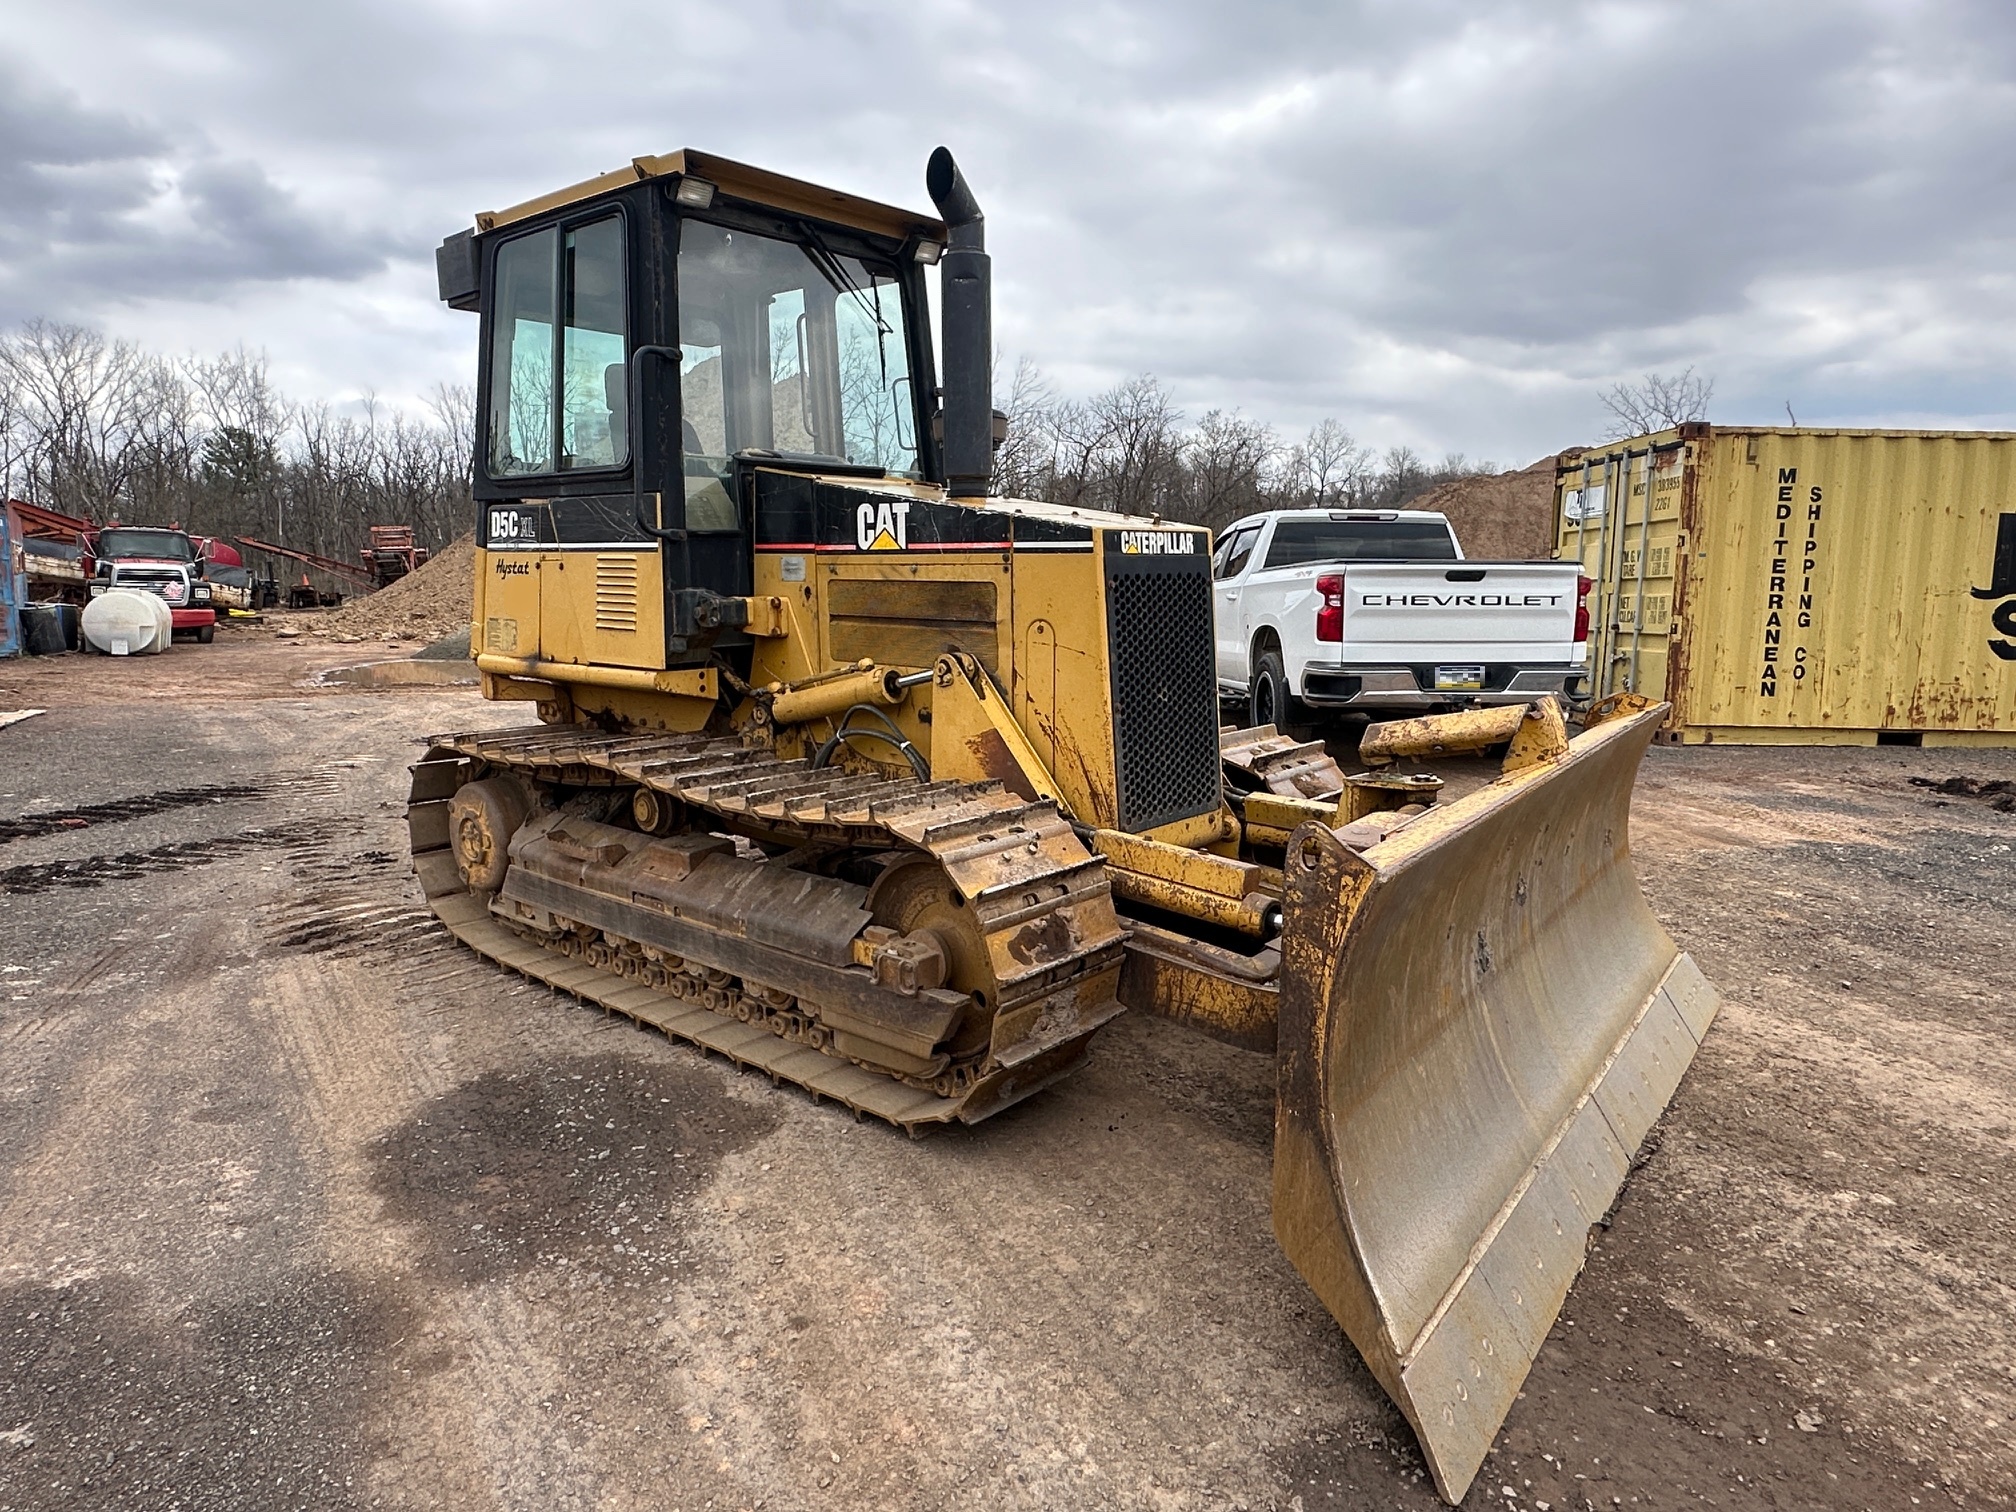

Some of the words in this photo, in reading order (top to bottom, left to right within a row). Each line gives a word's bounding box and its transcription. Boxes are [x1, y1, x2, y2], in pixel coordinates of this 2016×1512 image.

[491, 511, 518, 538] D5C
[857, 502, 909, 550] CAT
[1121, 531, 1194, 554] CATERPILLAR
[1798, 486, 1822, 628] SHIPPING
[496, 558, 529, 580] Hystat
[1760, 468, 1797, 697] MEDITERRANEAN
[1362, 594, 1563, 606] CHEVROLET
[1793, 647, 1807, 680] CO
